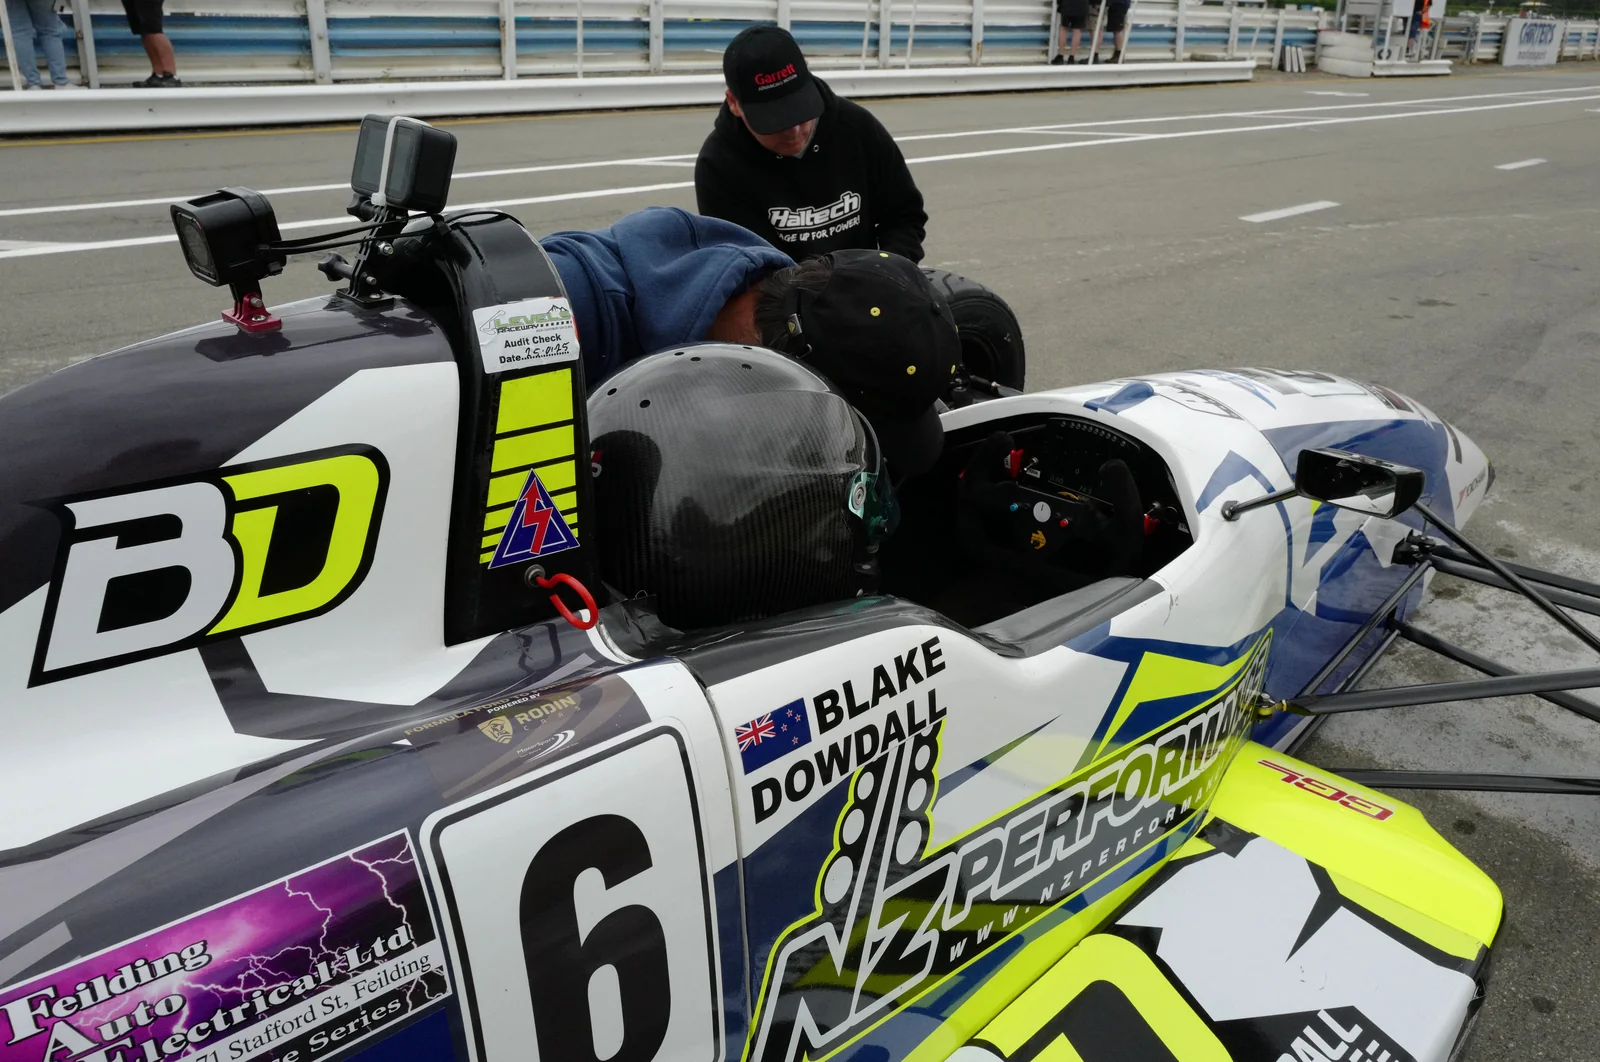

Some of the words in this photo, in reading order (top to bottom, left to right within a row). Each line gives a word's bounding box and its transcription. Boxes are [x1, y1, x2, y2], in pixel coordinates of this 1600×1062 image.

[754, 63, 796, 86] Garrett
[769, 191, 861, 231] Haltech
[799, 233, 811, 242] UP
[811, 229, 829, 240] FOR
[829, 214, 861, 236] POWER!
[494, 310, 571, 329] LEVELS
[496, 324, 539, 334] RACEWAY
[504, 337, 530, 349] Audit
[532, 333, 562, 345] Check
[33, 446, 388, 682] BD
[487, 696, 529, 714] POWERED
[529, 692, 542, 700] BY
[812, 635, 946, 735] BLAKE
[405, 709, 475, 736] FORMULA
[514, 695, 577, 725] RODIN
[751, 688, 948, 825] DOWDALL
[343, 924, 414, 972] Ltd
[519, 813, 672, 1062] 6
[1, 939, 213, 1046] Feilding
[228, 1004, 318, 1061] Stafford
[321, 994, 350, 1017] St,
[352, 953, 432, 1001] Feilding
[42, 993, 187, 1062] Auto
[308, 997, 402, 1053] Series
[1275, 1008, 1364, 1062] ALL
